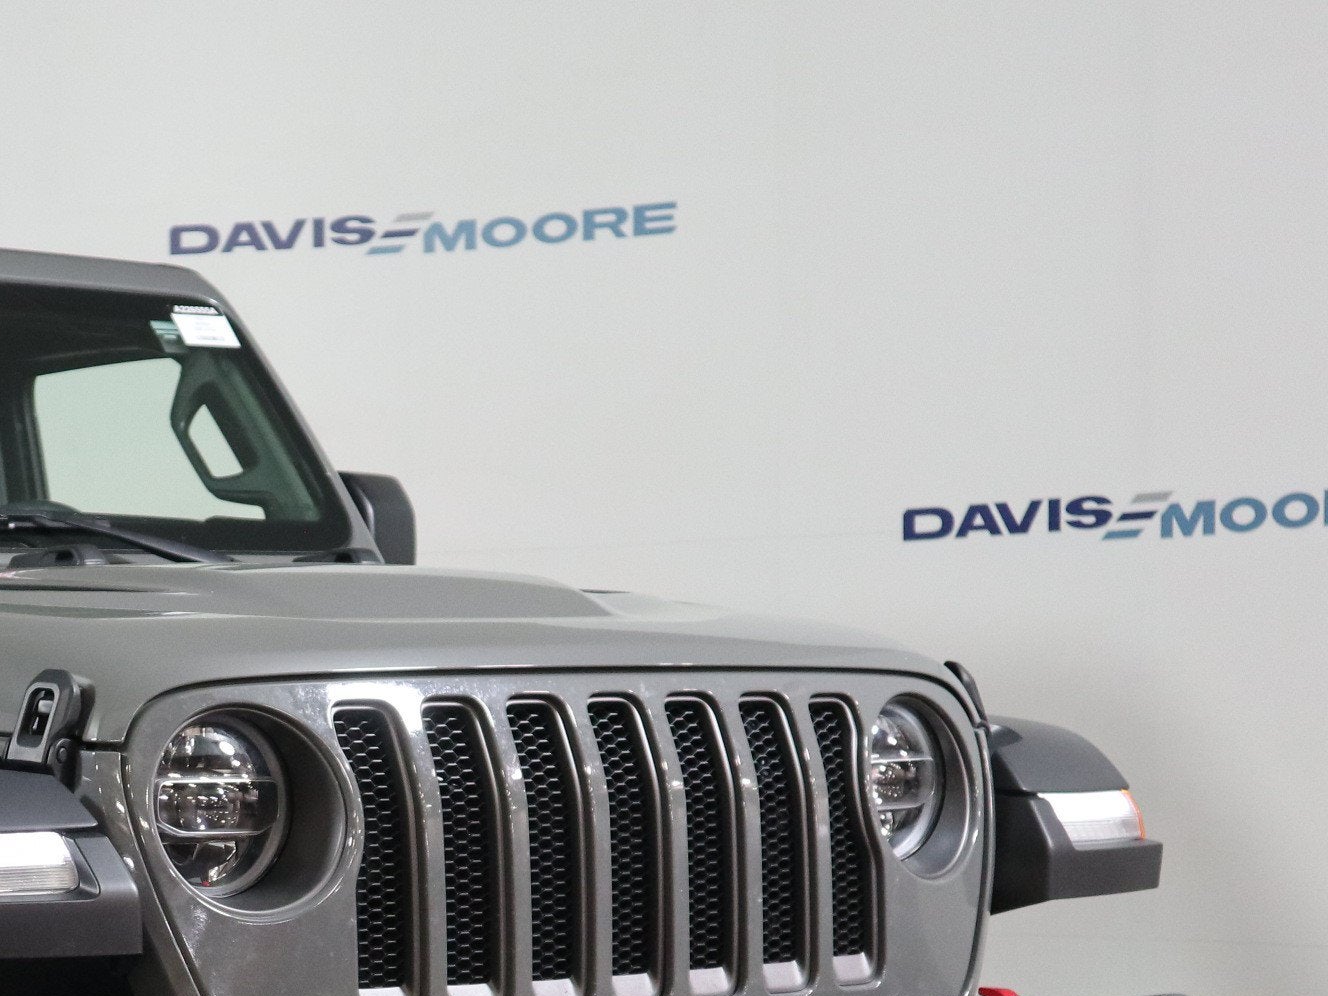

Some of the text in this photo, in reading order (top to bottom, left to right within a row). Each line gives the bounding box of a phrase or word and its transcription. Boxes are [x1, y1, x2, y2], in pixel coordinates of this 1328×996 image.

[170, 202, 678, 256] DAVIS MOORE
[903, 490, 1328, 541] DAVIS MOO
